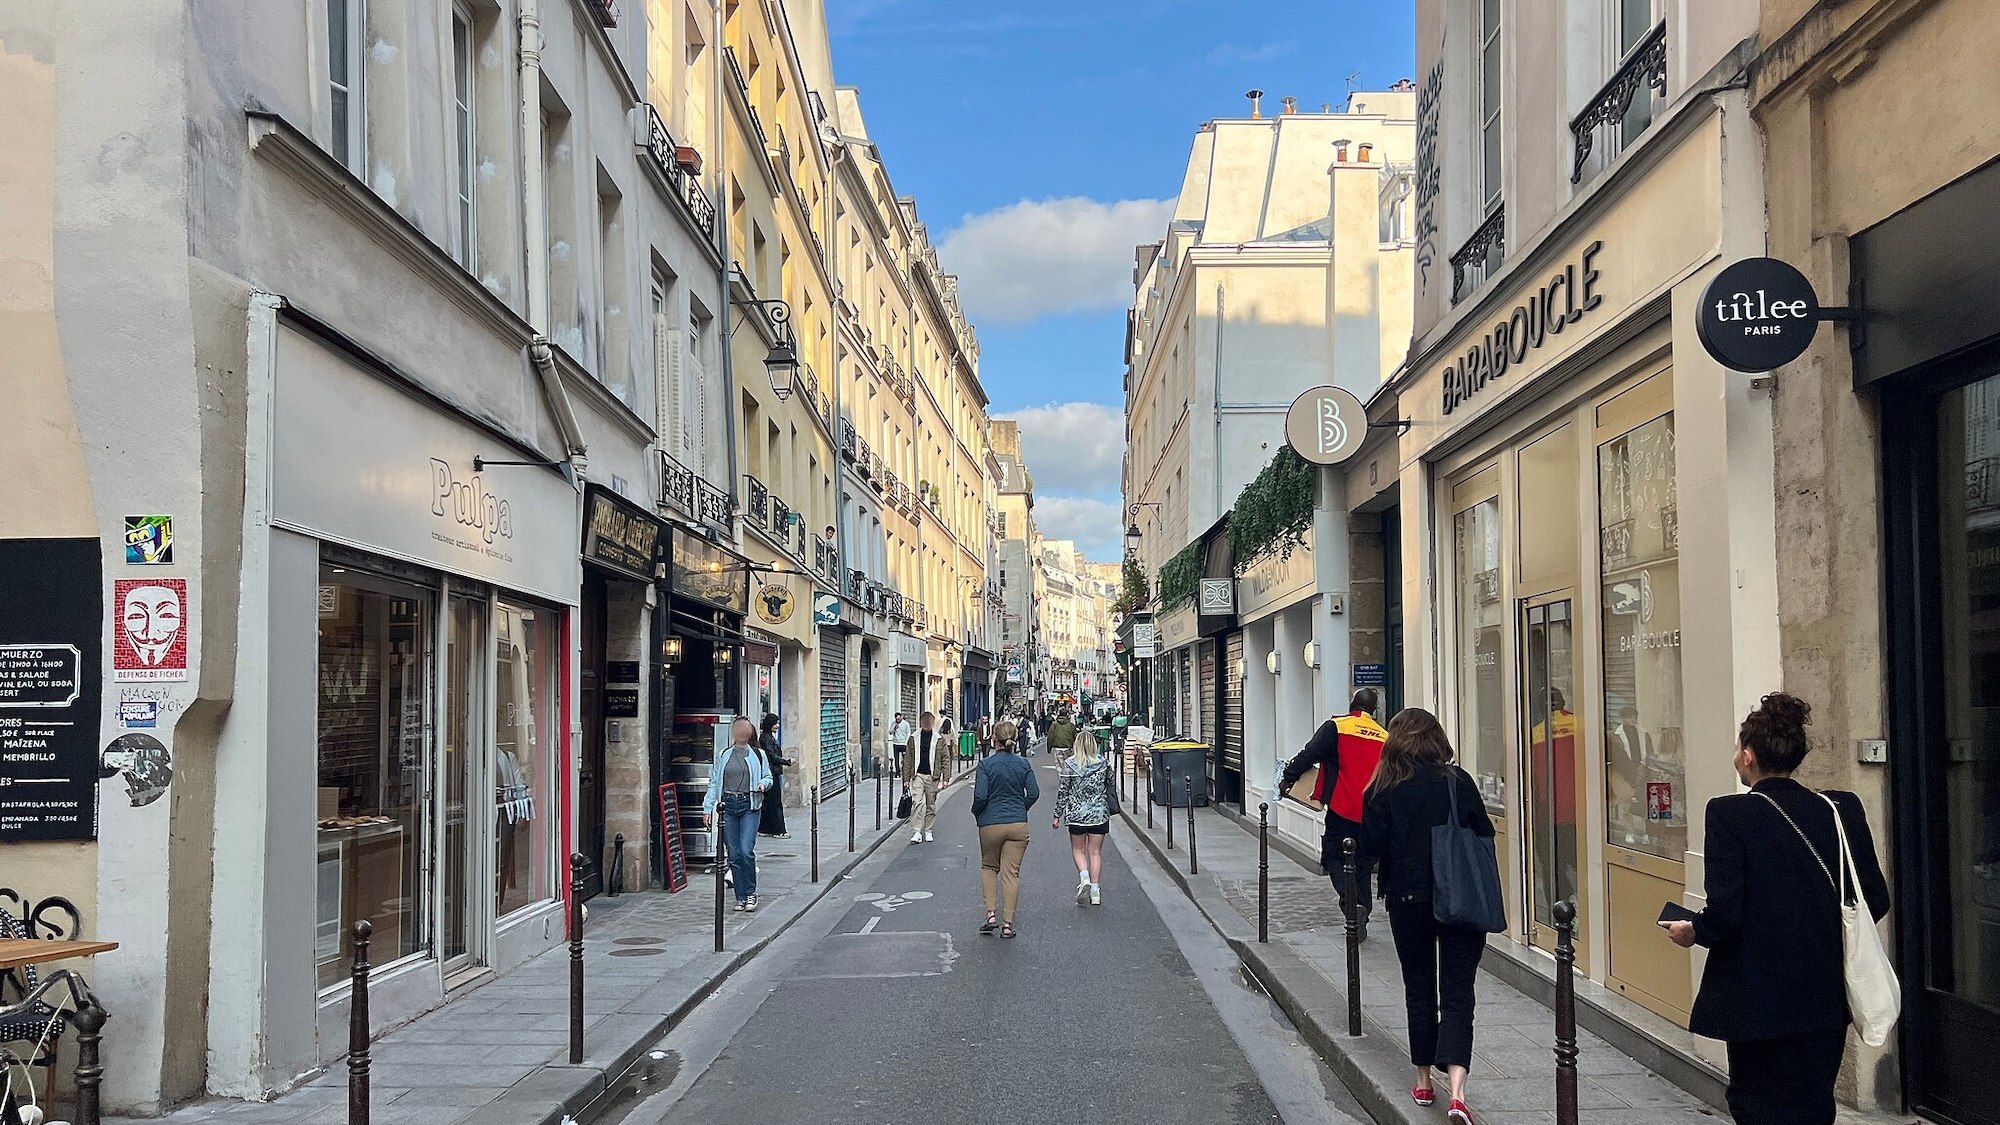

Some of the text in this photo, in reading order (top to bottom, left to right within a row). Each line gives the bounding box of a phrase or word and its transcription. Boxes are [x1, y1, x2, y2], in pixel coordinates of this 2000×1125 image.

[1715, 289, 1808, 321] titlee
[1442, 240, 1602, 415] BARABOUCLE
[1744, 325, 1781, 336] PARIS
[430, 457, 513, 544] Pulpa
[0, 650, 43, 659] MUERZO
[41, 660, 63, 668] 16H00
[3, 753, 56, 761] MEMBRILLO
